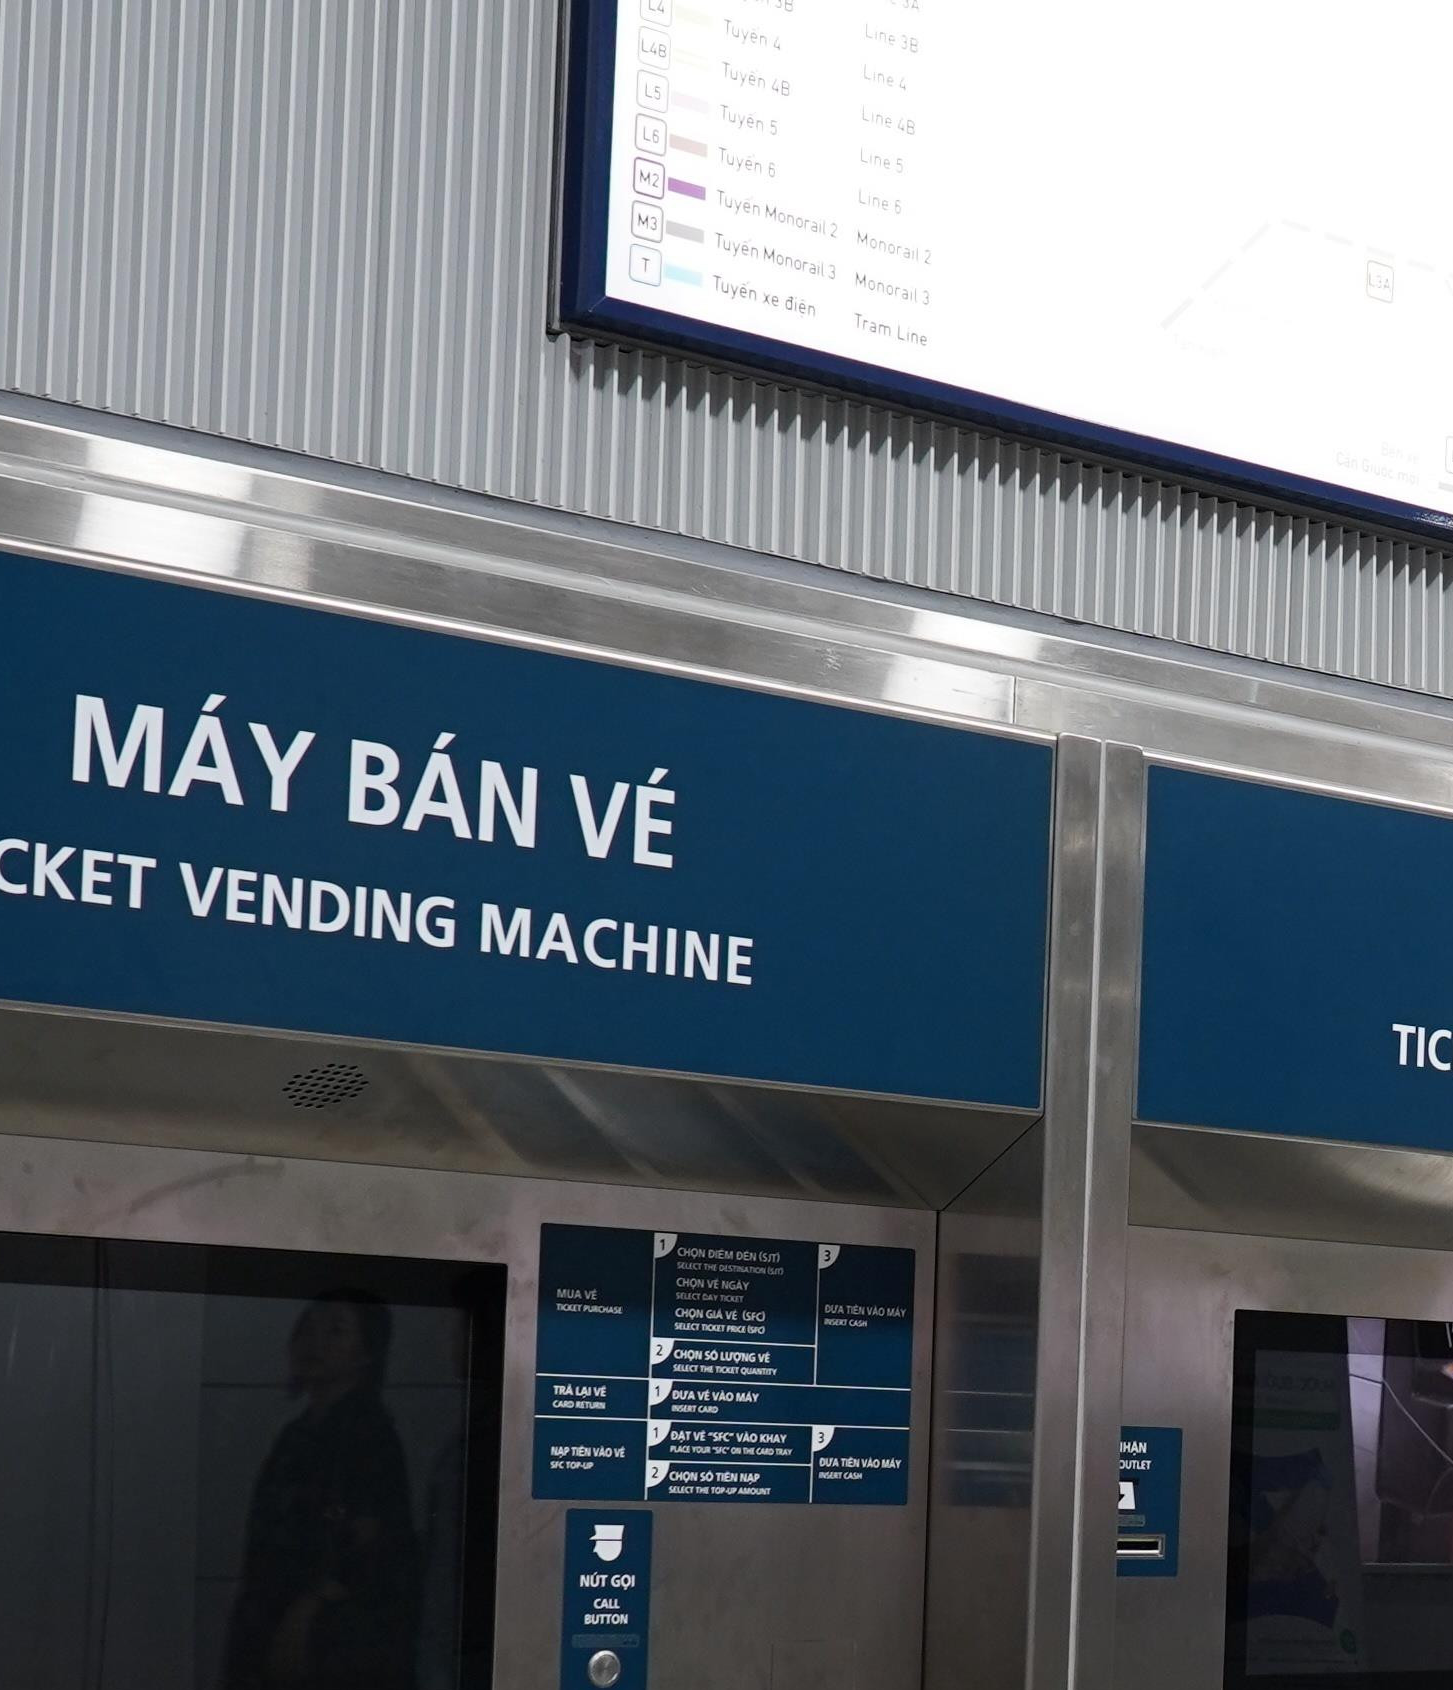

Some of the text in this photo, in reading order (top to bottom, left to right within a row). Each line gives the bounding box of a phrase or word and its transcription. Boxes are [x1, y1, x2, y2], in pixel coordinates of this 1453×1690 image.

[72, 694, 675, 868] MÁY BÁN VÉ
[179, 862, 455, 948] VENDING
[480, 903, 753, 985] MACHINE
[580, 1571, 635, 1590] NÚT GỌI
[593, 1598, 620, 1609] CALL
[584, 1614, 628, 1625] BUTTON
